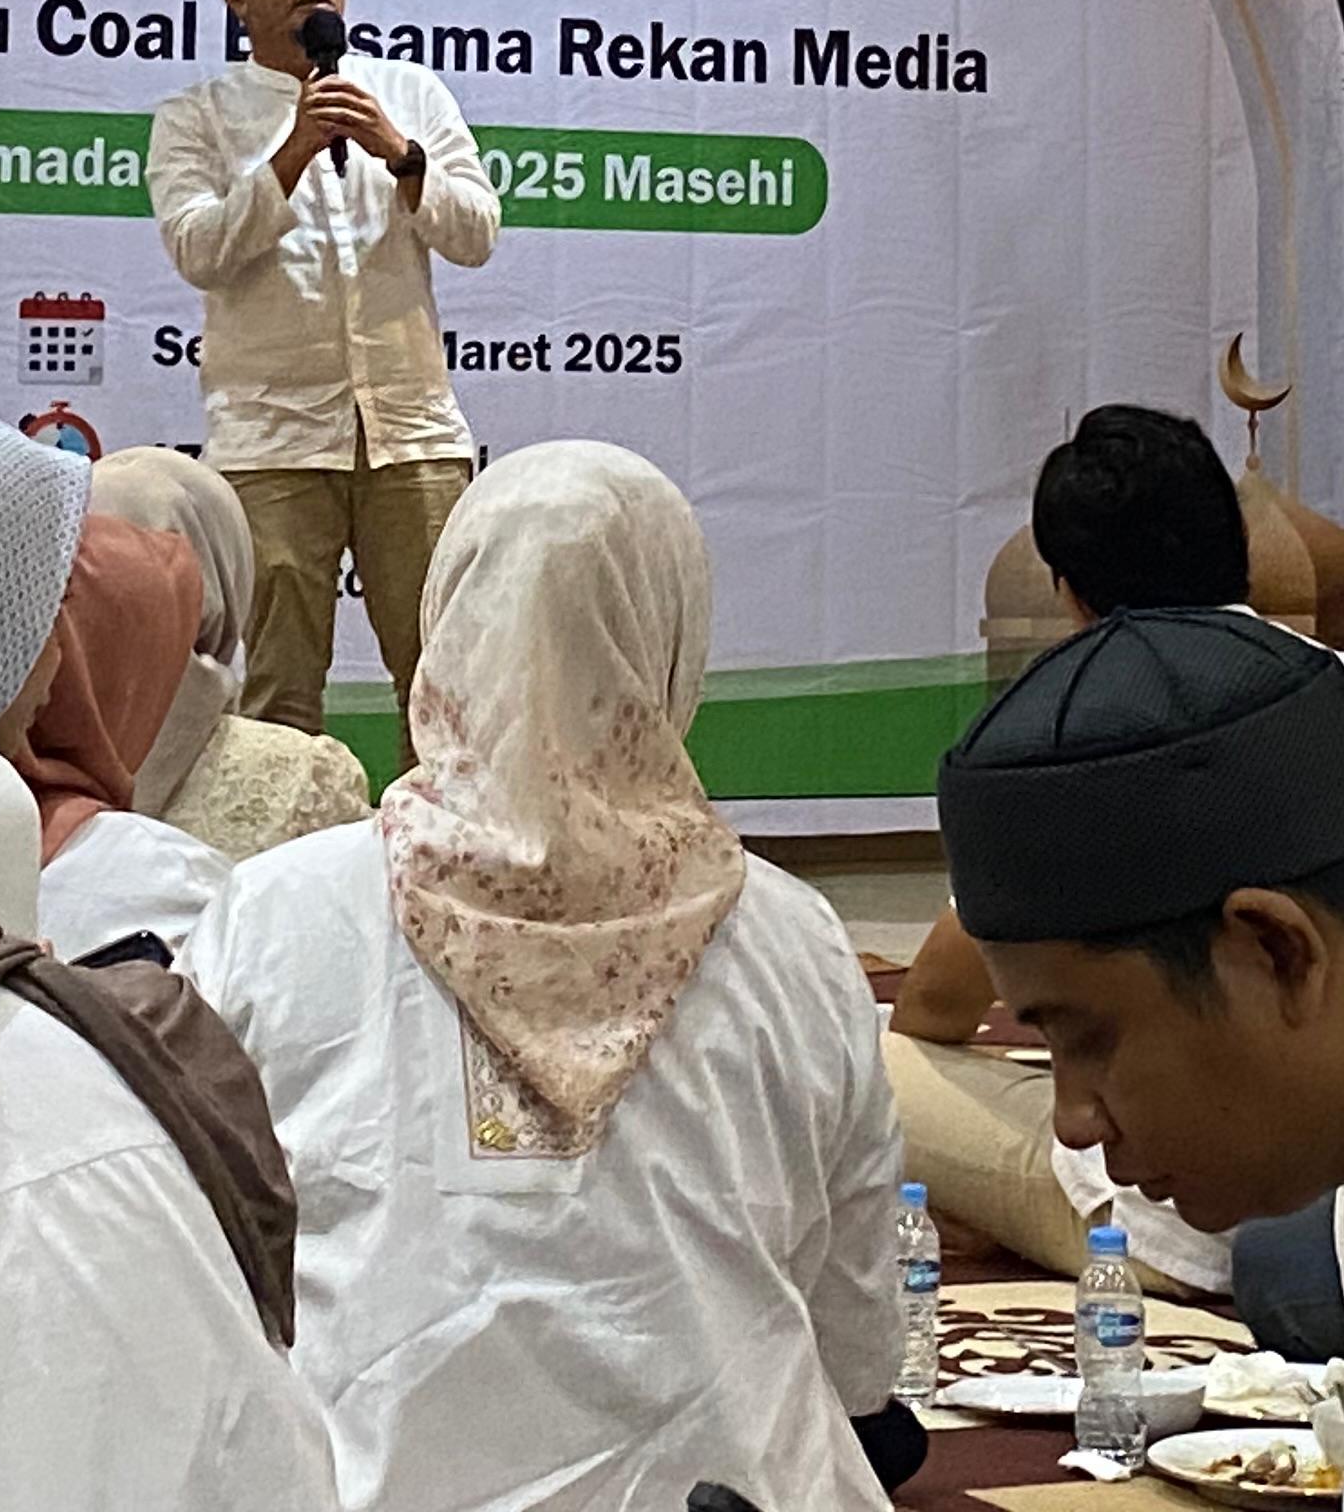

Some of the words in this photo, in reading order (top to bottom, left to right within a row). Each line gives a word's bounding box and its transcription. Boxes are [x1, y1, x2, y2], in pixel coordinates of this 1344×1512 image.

[559, 17, 767, 84] Rekan
[793, 28, 989, 93] Media
[481, 149, 586, 201] 025
[604, 154, 794, 207] Masehi
[564, 332, 682, 374] 2025
